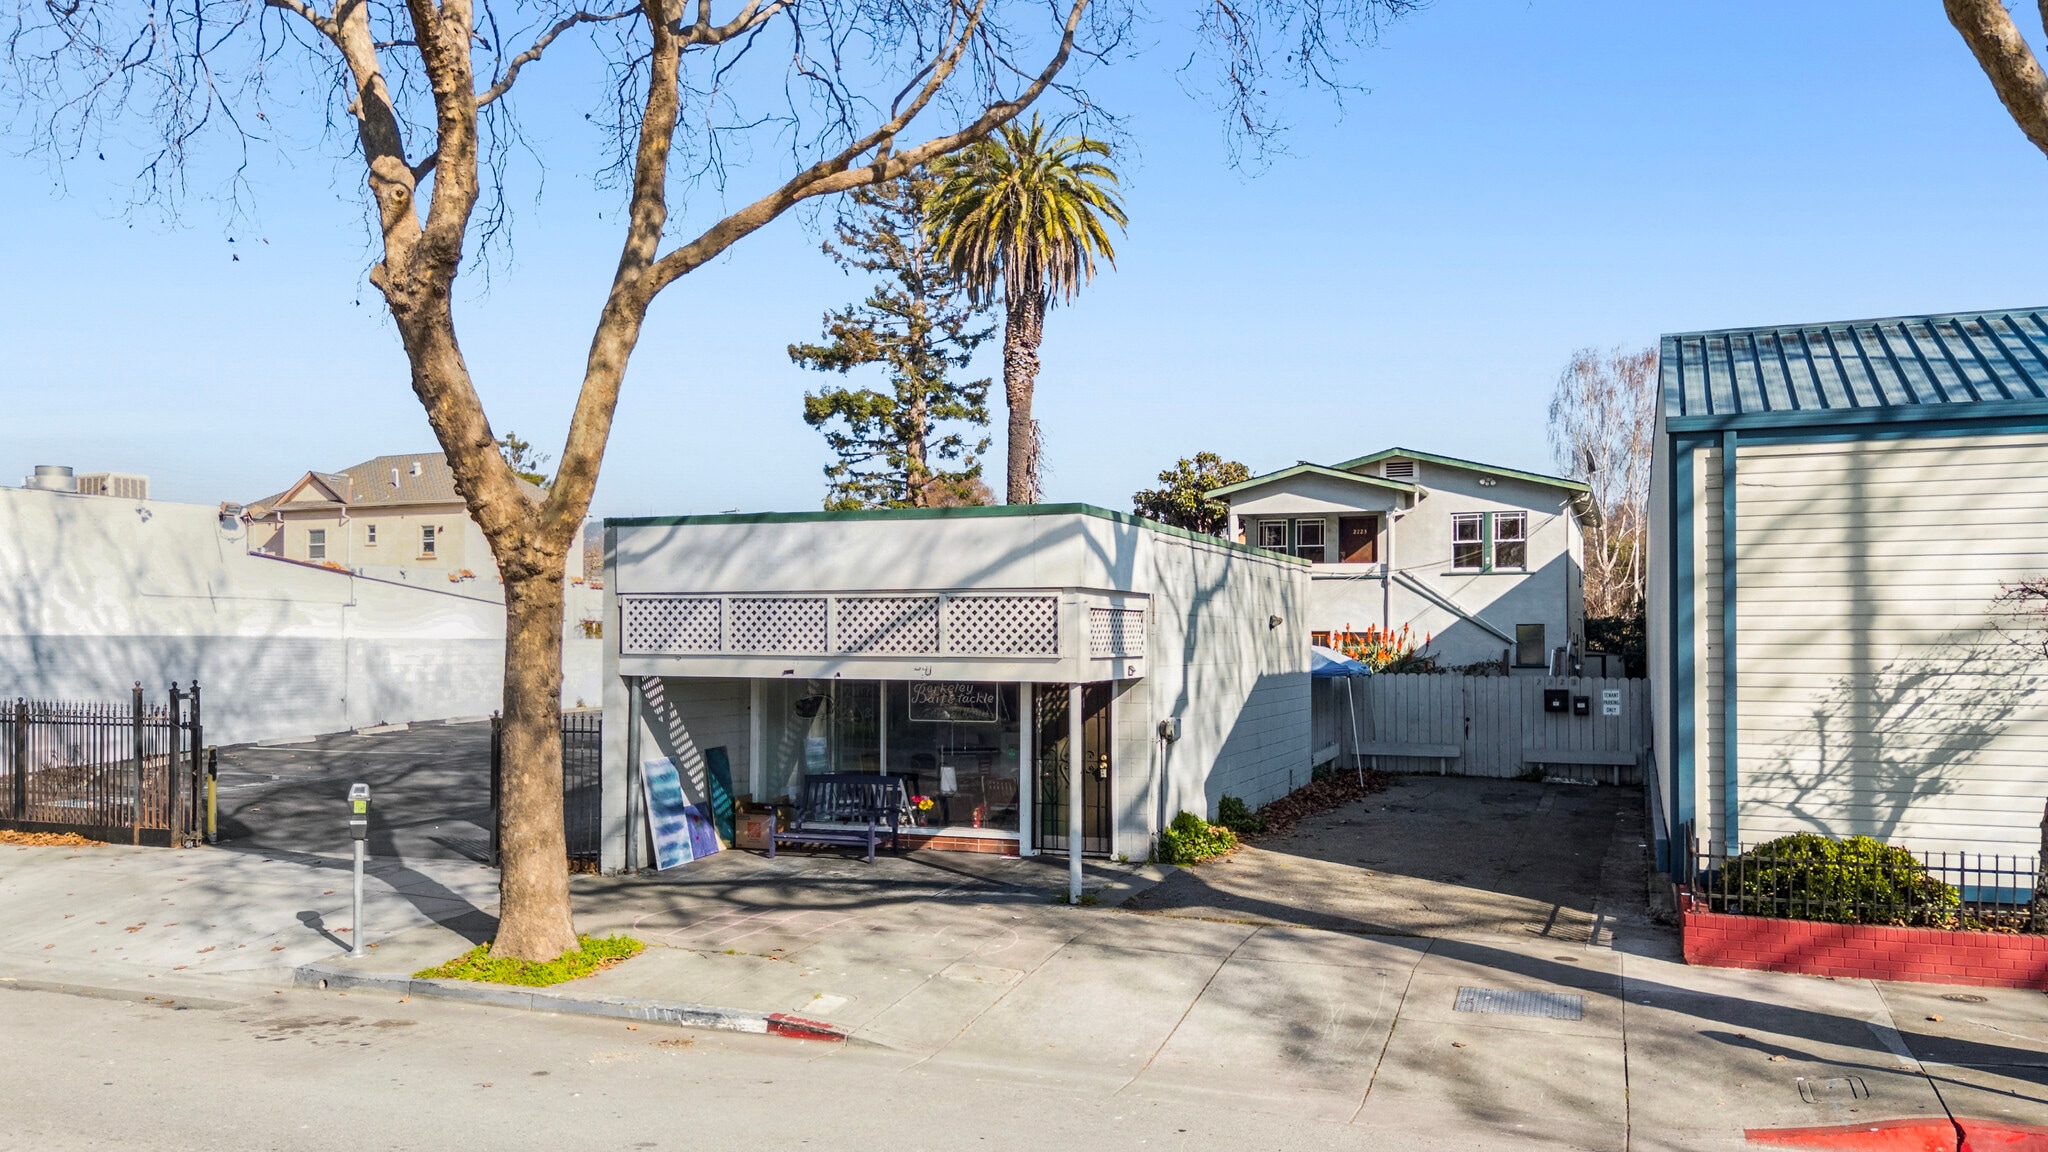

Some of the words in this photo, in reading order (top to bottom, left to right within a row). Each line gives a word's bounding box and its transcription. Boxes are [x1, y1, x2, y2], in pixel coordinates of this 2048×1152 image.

[912, 682, 974, 695] Berkeley
[911, 690, 947, 705] Bait
[947, 694, 956, 704] &
